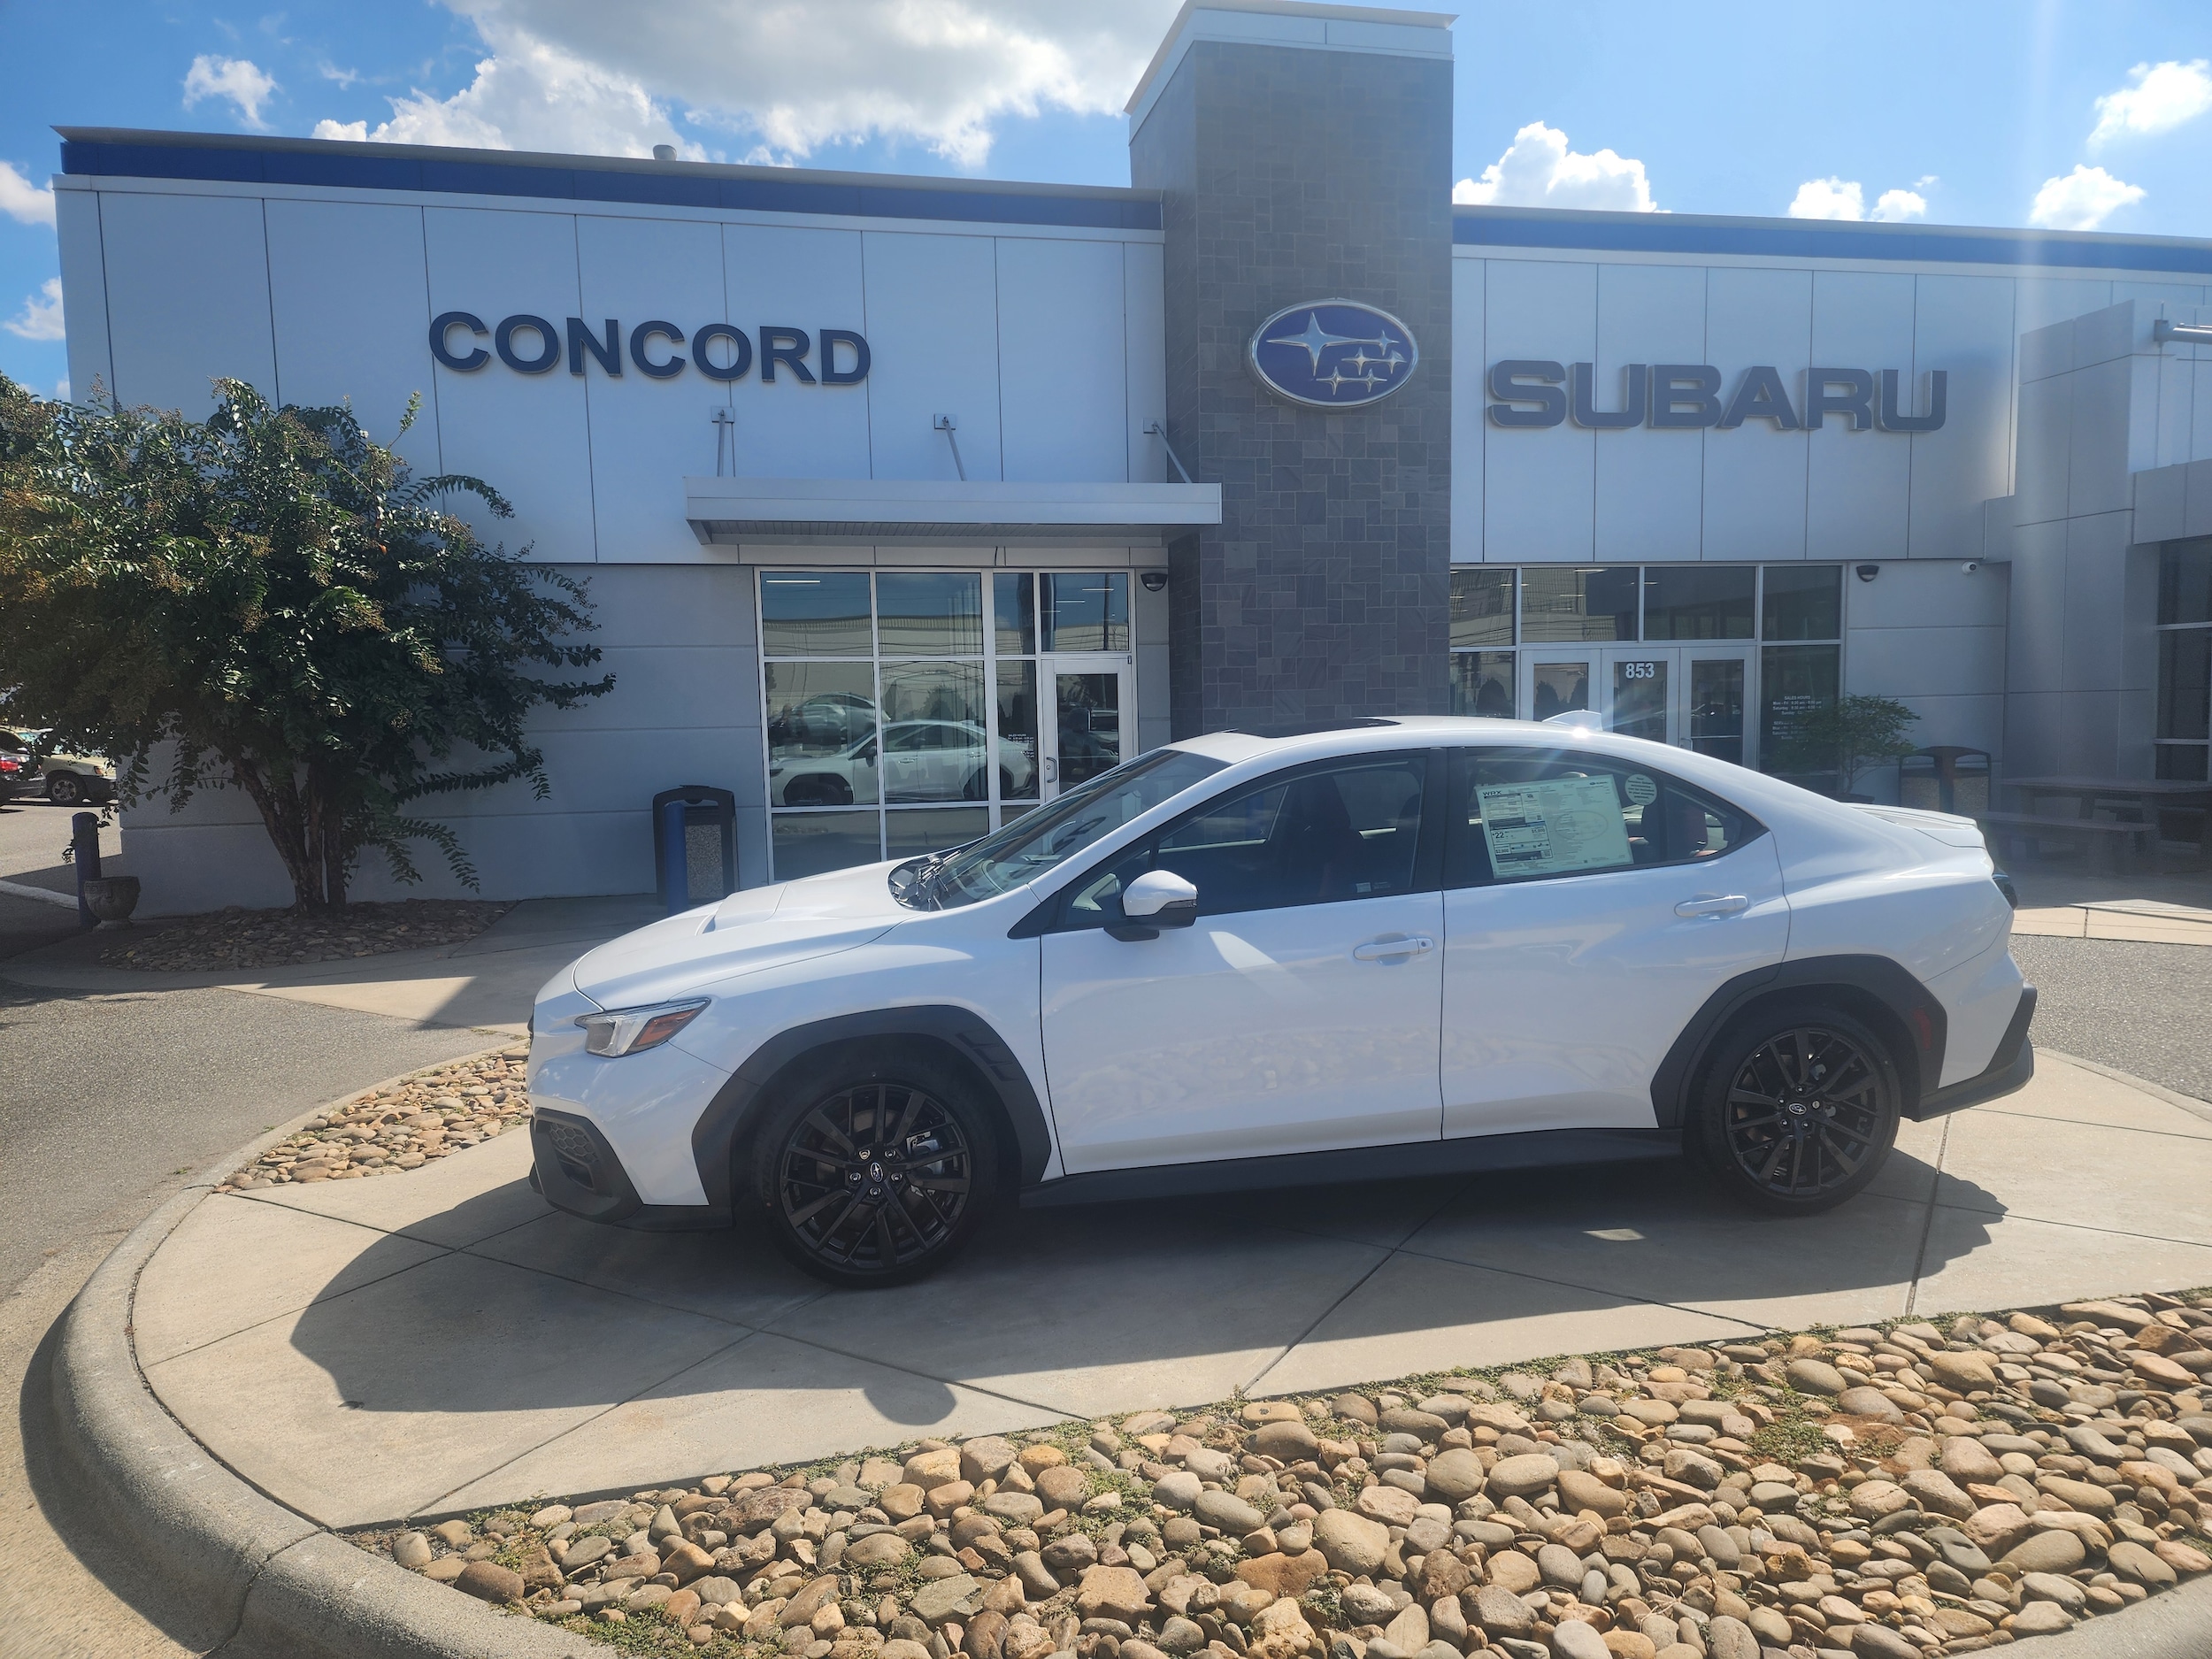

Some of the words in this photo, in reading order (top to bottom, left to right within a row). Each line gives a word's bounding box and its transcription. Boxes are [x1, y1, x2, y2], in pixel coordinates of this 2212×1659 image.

[428, 311, 872, 385] CONCORD
[1487, 359, 1947, 432] SUBARU
[1625, 663, 1655, 679] 853
